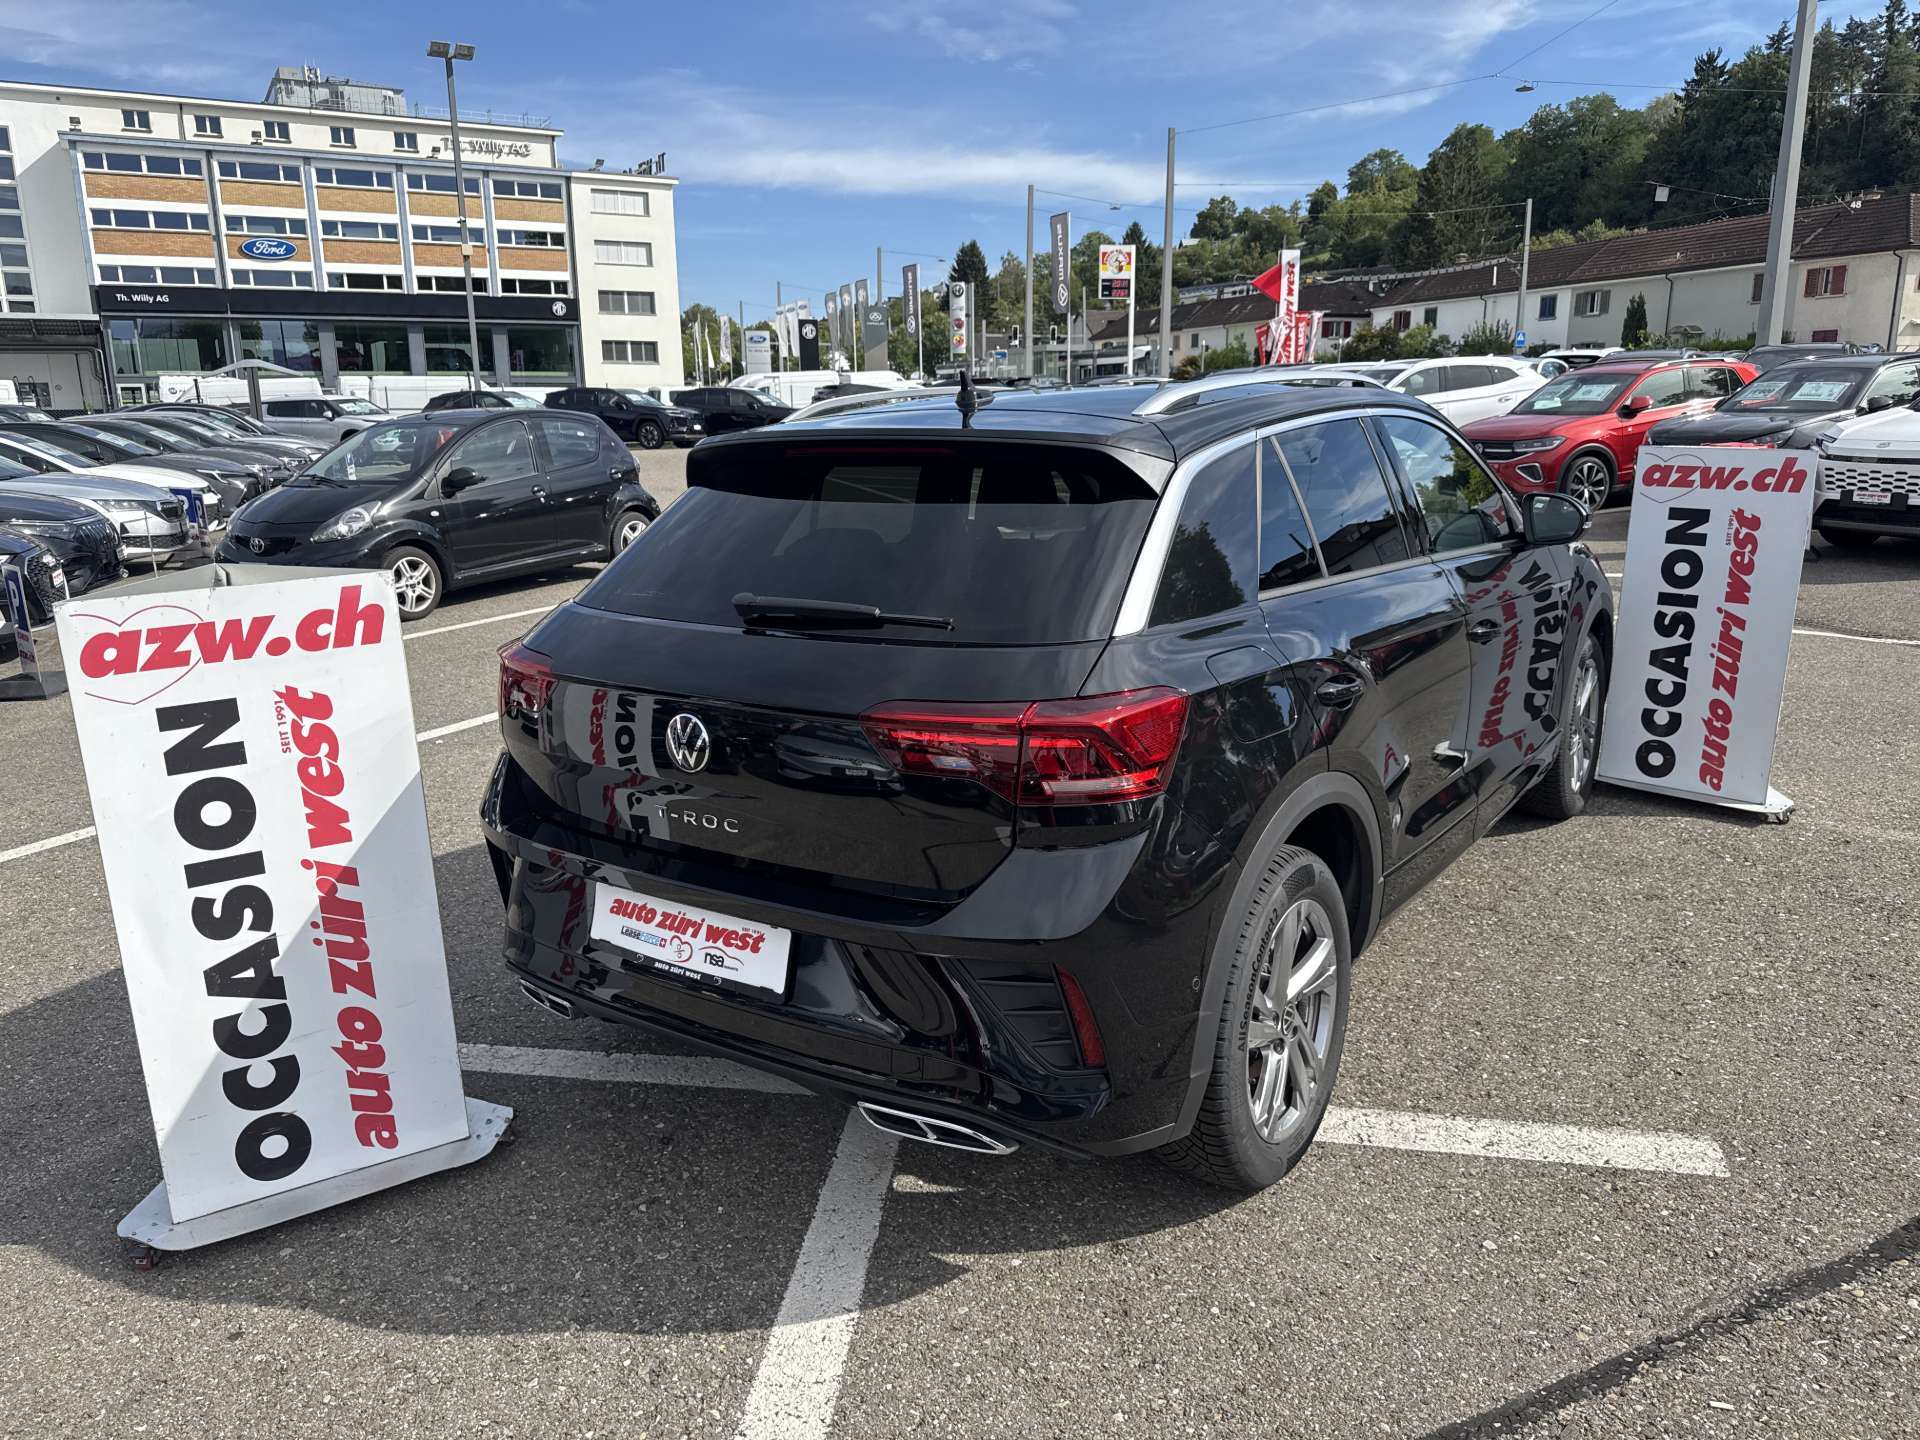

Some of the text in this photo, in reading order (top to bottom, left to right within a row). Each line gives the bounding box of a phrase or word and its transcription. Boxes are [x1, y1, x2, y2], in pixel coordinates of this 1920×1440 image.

[251, 240, 287, 257] Ford
[115, 293, 169, 304] Th. Willy AG
[801, 323, 817, 340] MG
[1641, 456, 1808, 494] azw.ch
[1725, 531, 1733, 546] SEIT
[79, 584, 386, 679] azw.ch
[1635, 507, 1711, 779] OCCASION
[1699, 507, 1762, 792] auto züri west
[273, 699, 293, 755] SEIT 1991
[655, 804, 739, 833] T-ROC
[272, 684, 399, 1150] auto züri west
[609, 898, 767, 954] auto züri west
[155, 697, 312, 1181] OCCASION
[654, 960, 702, 980] auto züri west
[704, 951, 724, 968] nsa
